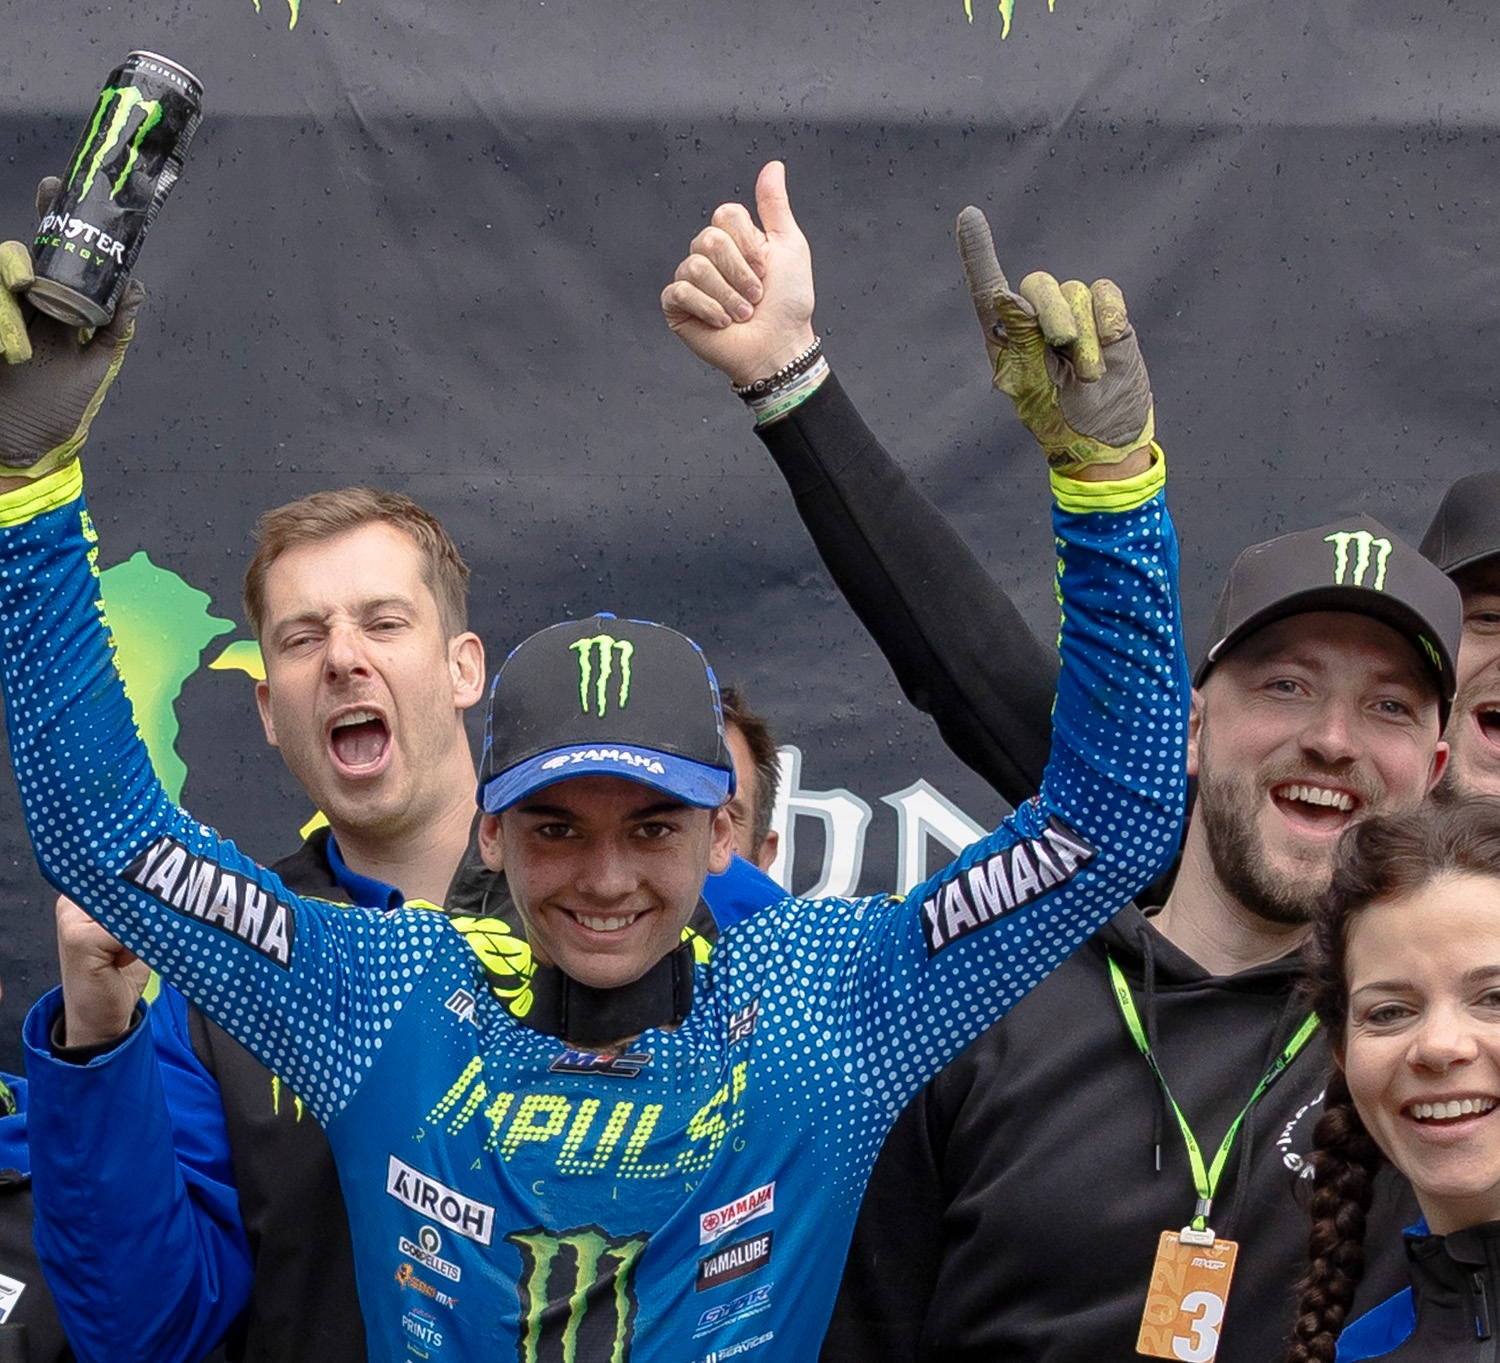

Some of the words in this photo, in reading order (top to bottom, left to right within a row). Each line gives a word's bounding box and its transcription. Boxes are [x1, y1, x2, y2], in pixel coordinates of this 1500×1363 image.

[39, 212, 125, 264] ONSTER
[571, 749, 665, 775] YAMAHA
[134, 838, 290, 964] YAMAHA
[393, 1169, 486, 1237] AIROH
[719, 1185, 772, 1225] YAMAHA
[401, 1240, 460, 1280] CORPELLETS
[702, 1237, 770, 1279] YAMALUBE
[402, 1315, 443, 1347] PRINTS
[1172, 1289, 1225, 1363] 3
